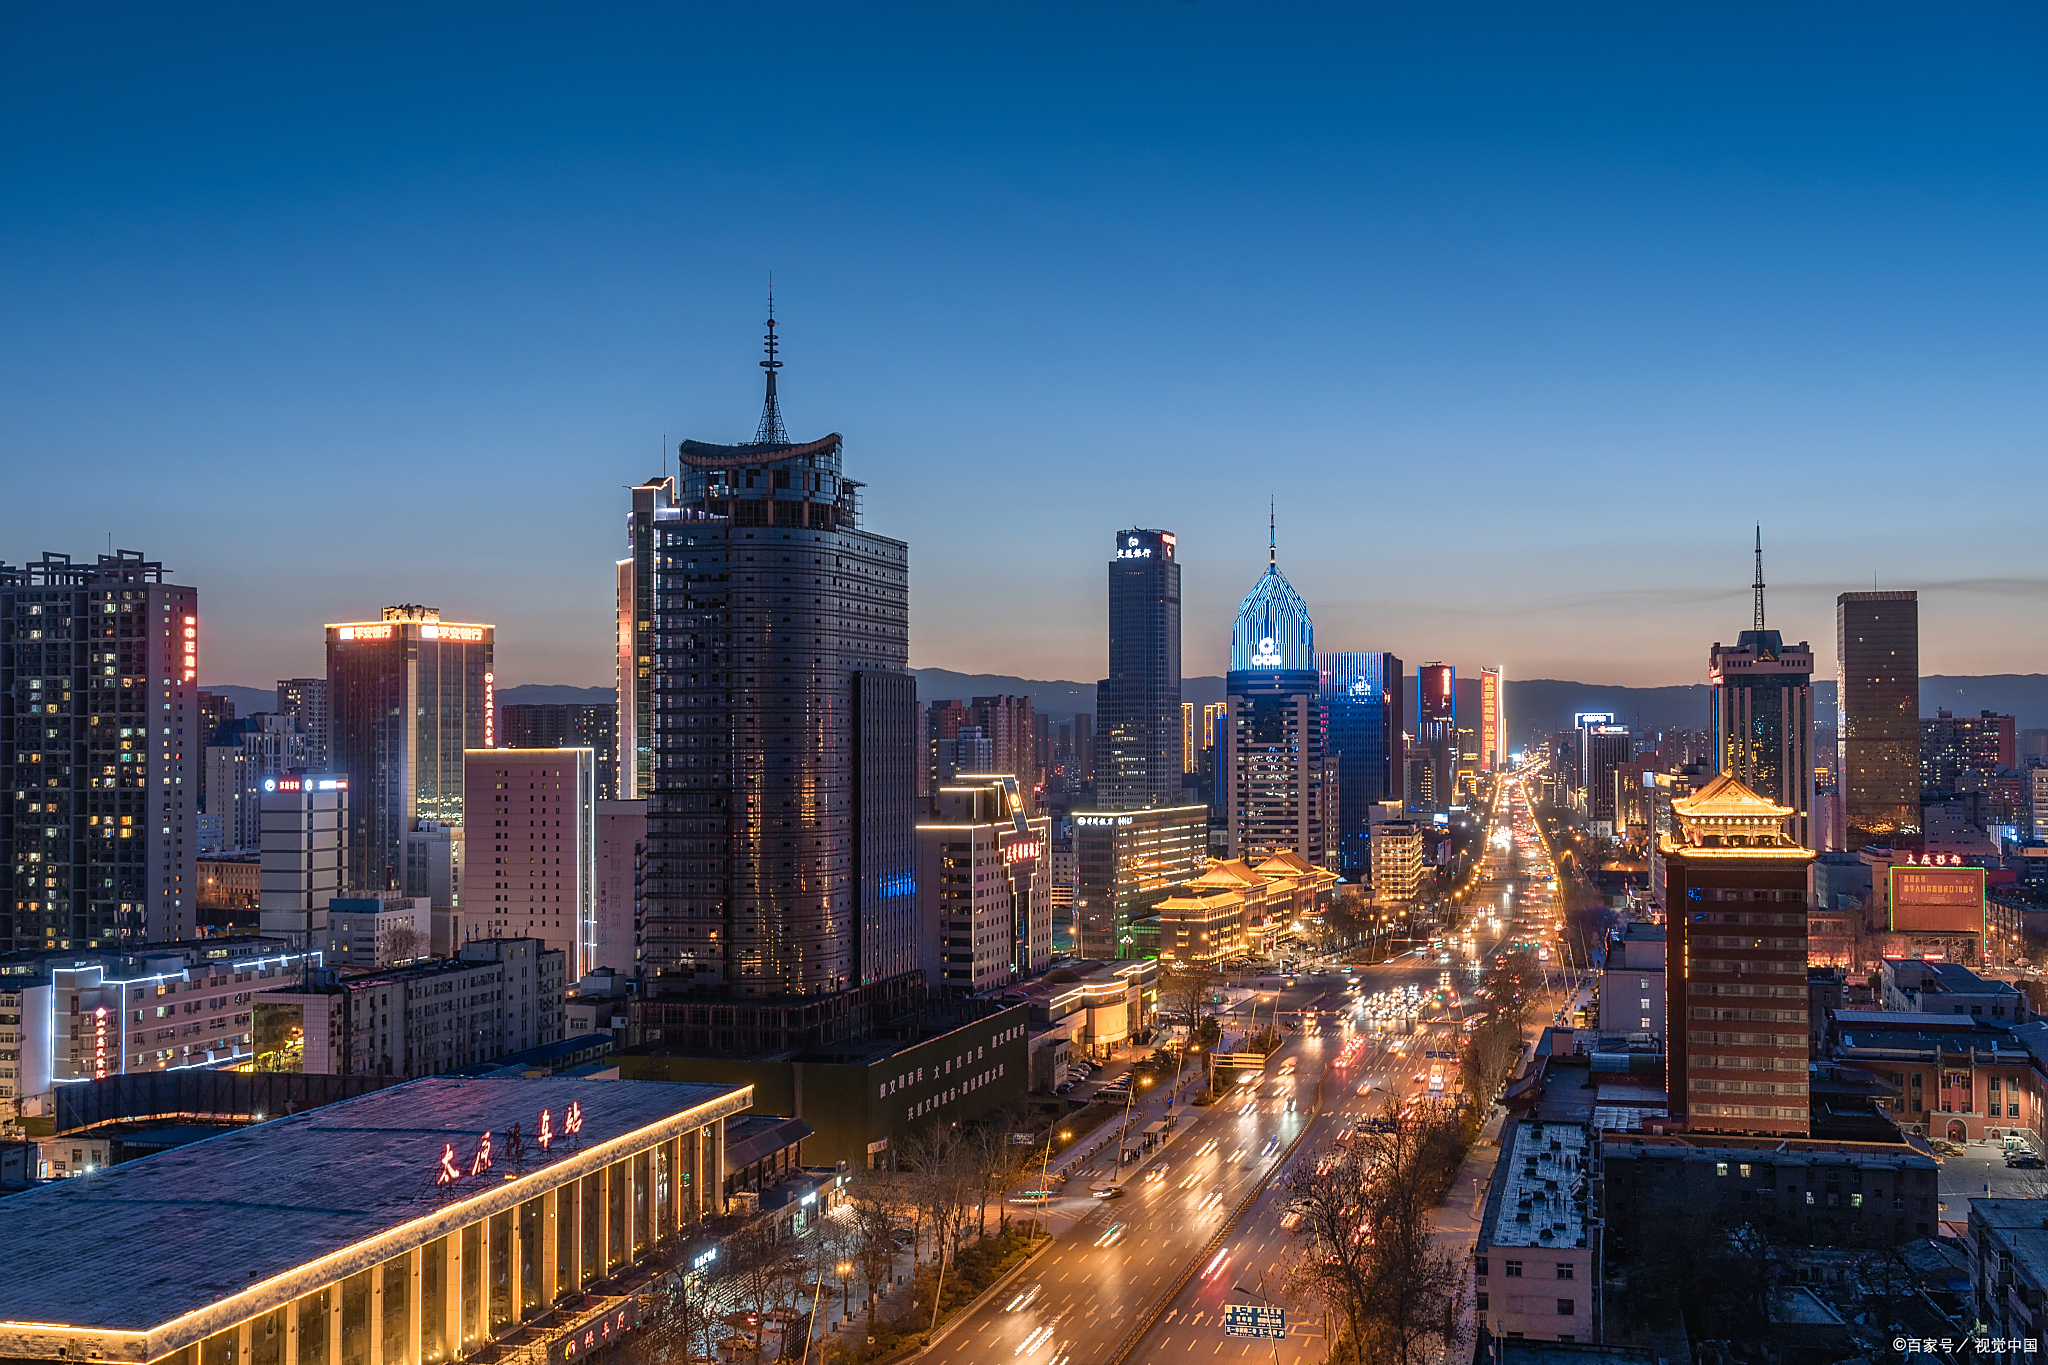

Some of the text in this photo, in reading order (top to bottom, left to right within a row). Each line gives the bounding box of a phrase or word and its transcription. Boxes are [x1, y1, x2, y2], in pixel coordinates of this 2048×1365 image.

[354, 626, 392, 640] 平安银行
[438, 626, 483, 641] 平安银行
